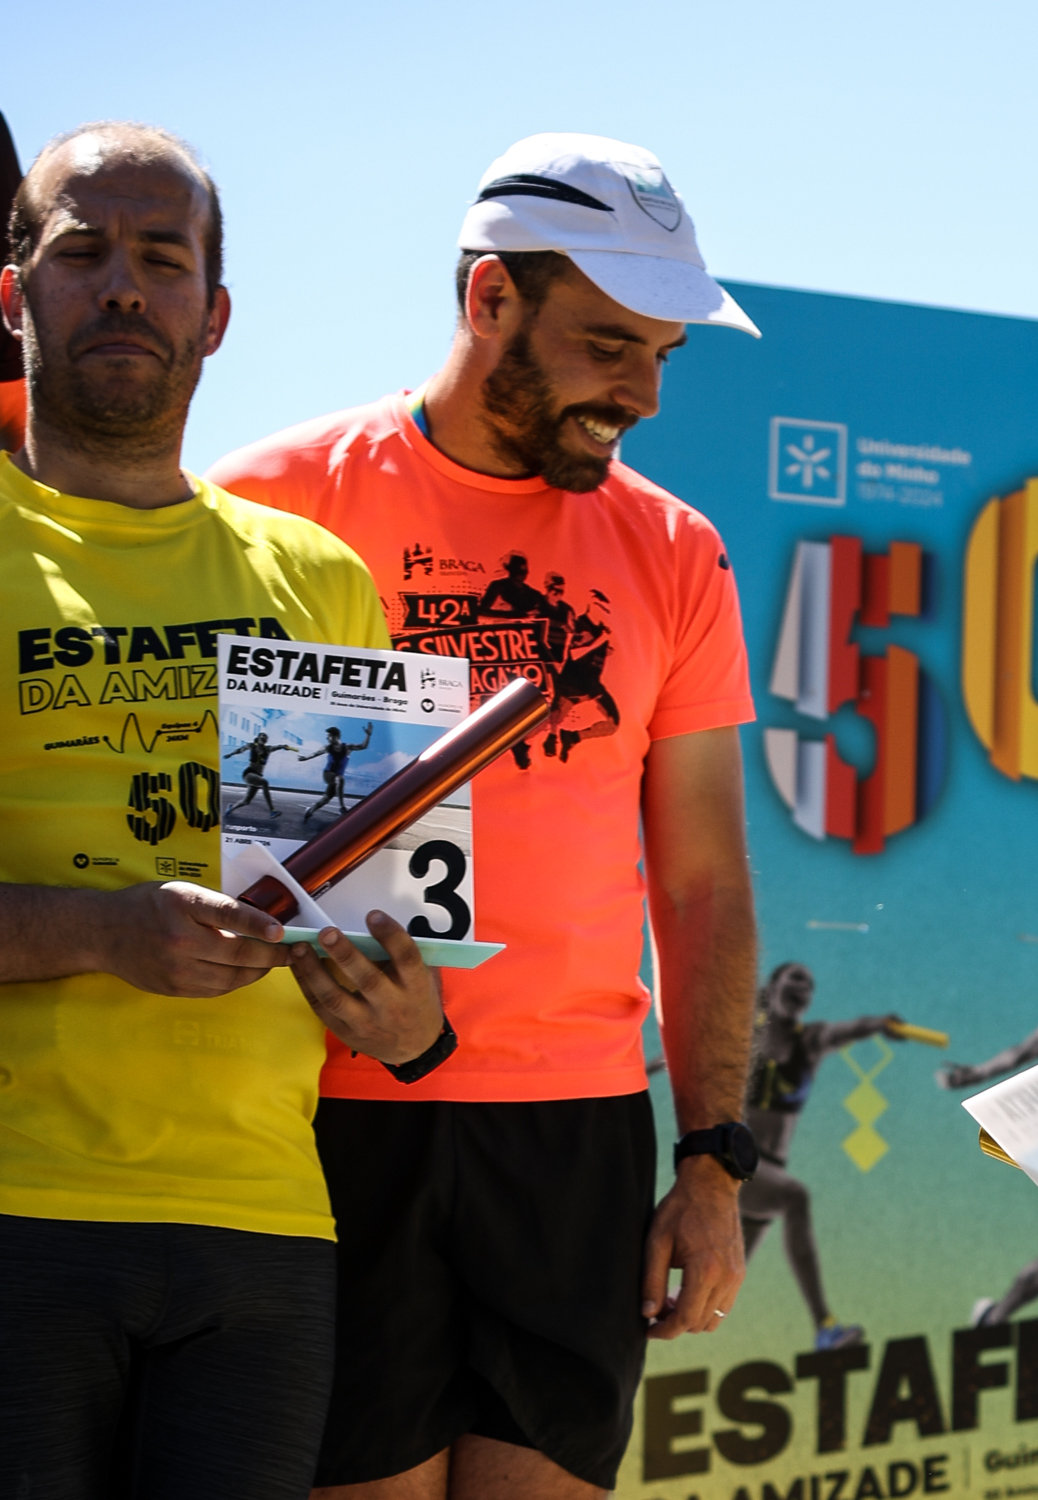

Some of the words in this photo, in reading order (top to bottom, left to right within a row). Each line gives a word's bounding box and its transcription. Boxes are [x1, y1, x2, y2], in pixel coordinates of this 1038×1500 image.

[439, 558, 486, 574] BRAGA
[99, 663, 218, 704] AMIZ
[226, 644, 407, 692] ESTAFETA
[18, 674, 91, 715] DA
[227, 679, 248, 692] DA
[251, 681, 321, 699] AMIZADE
[126, 761, 219, 846] 50
[407, 839, 471, 941] 3
